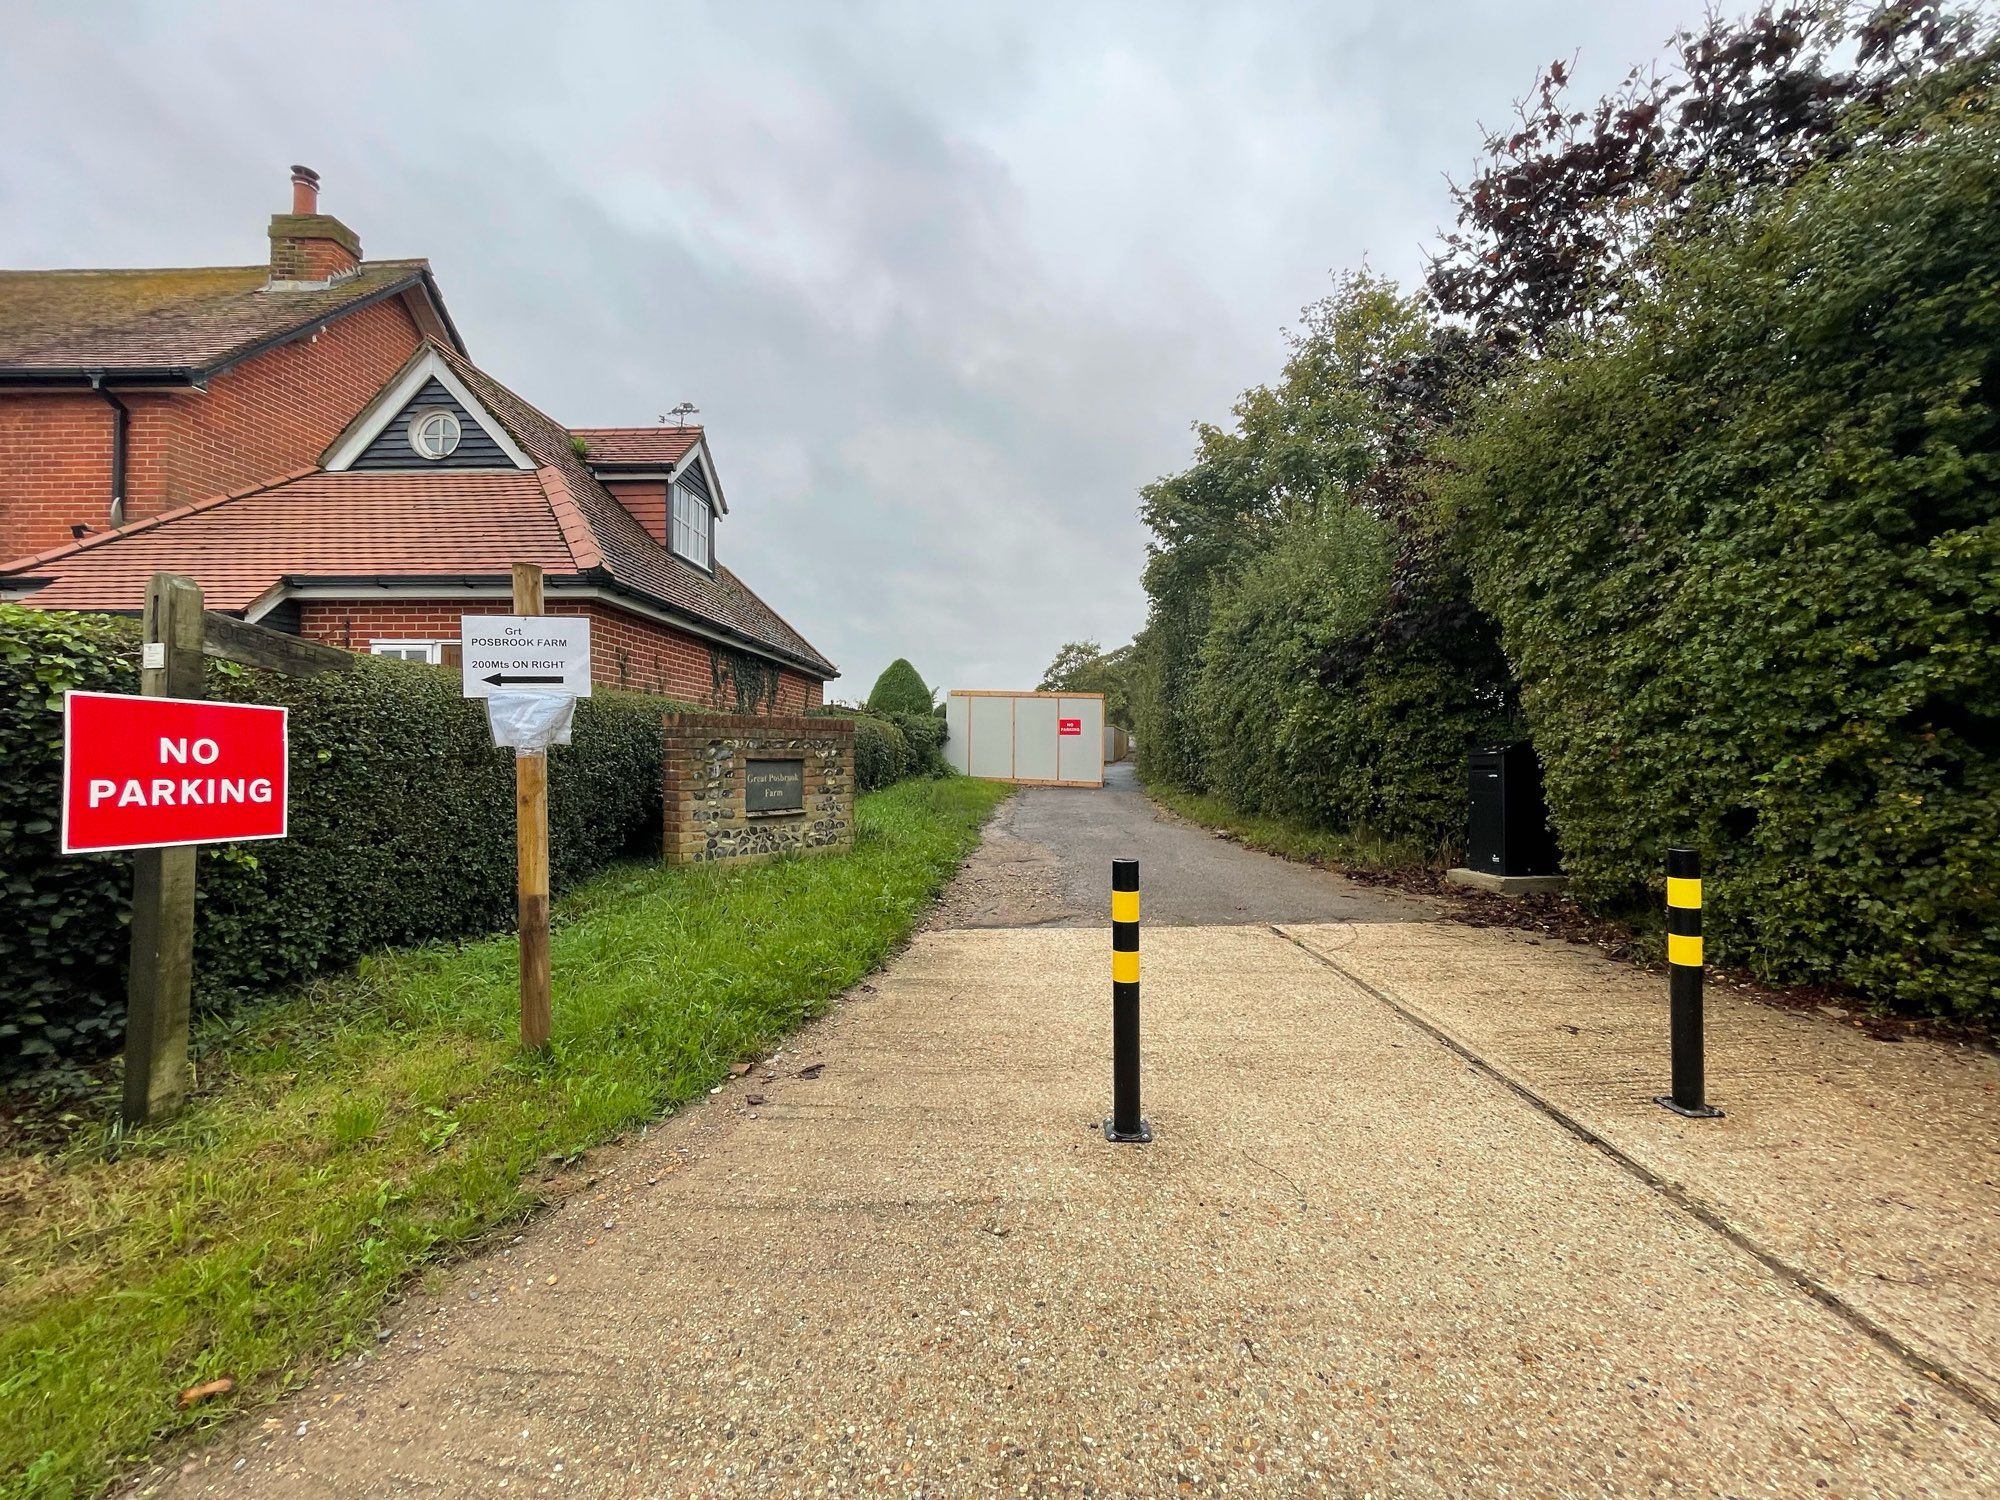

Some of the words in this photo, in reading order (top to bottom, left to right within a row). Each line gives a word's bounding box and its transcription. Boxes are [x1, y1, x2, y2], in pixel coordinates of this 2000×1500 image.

[505, 627, 522, 636] Grt
[471, 638, 534, 647] POSBROOK
[537, 639, 567, 647] FARM
[472, 660, 510, 669] 200Mts
[512, 661, 529, 669] ON
[531, 661, 565, 669] RIGHT
[160, 737, 219, 765] NO
[747, 774, 767, 783] Great
[89, 778, 272, 808] PARKING
[765, 789, 783, 797] Farm
